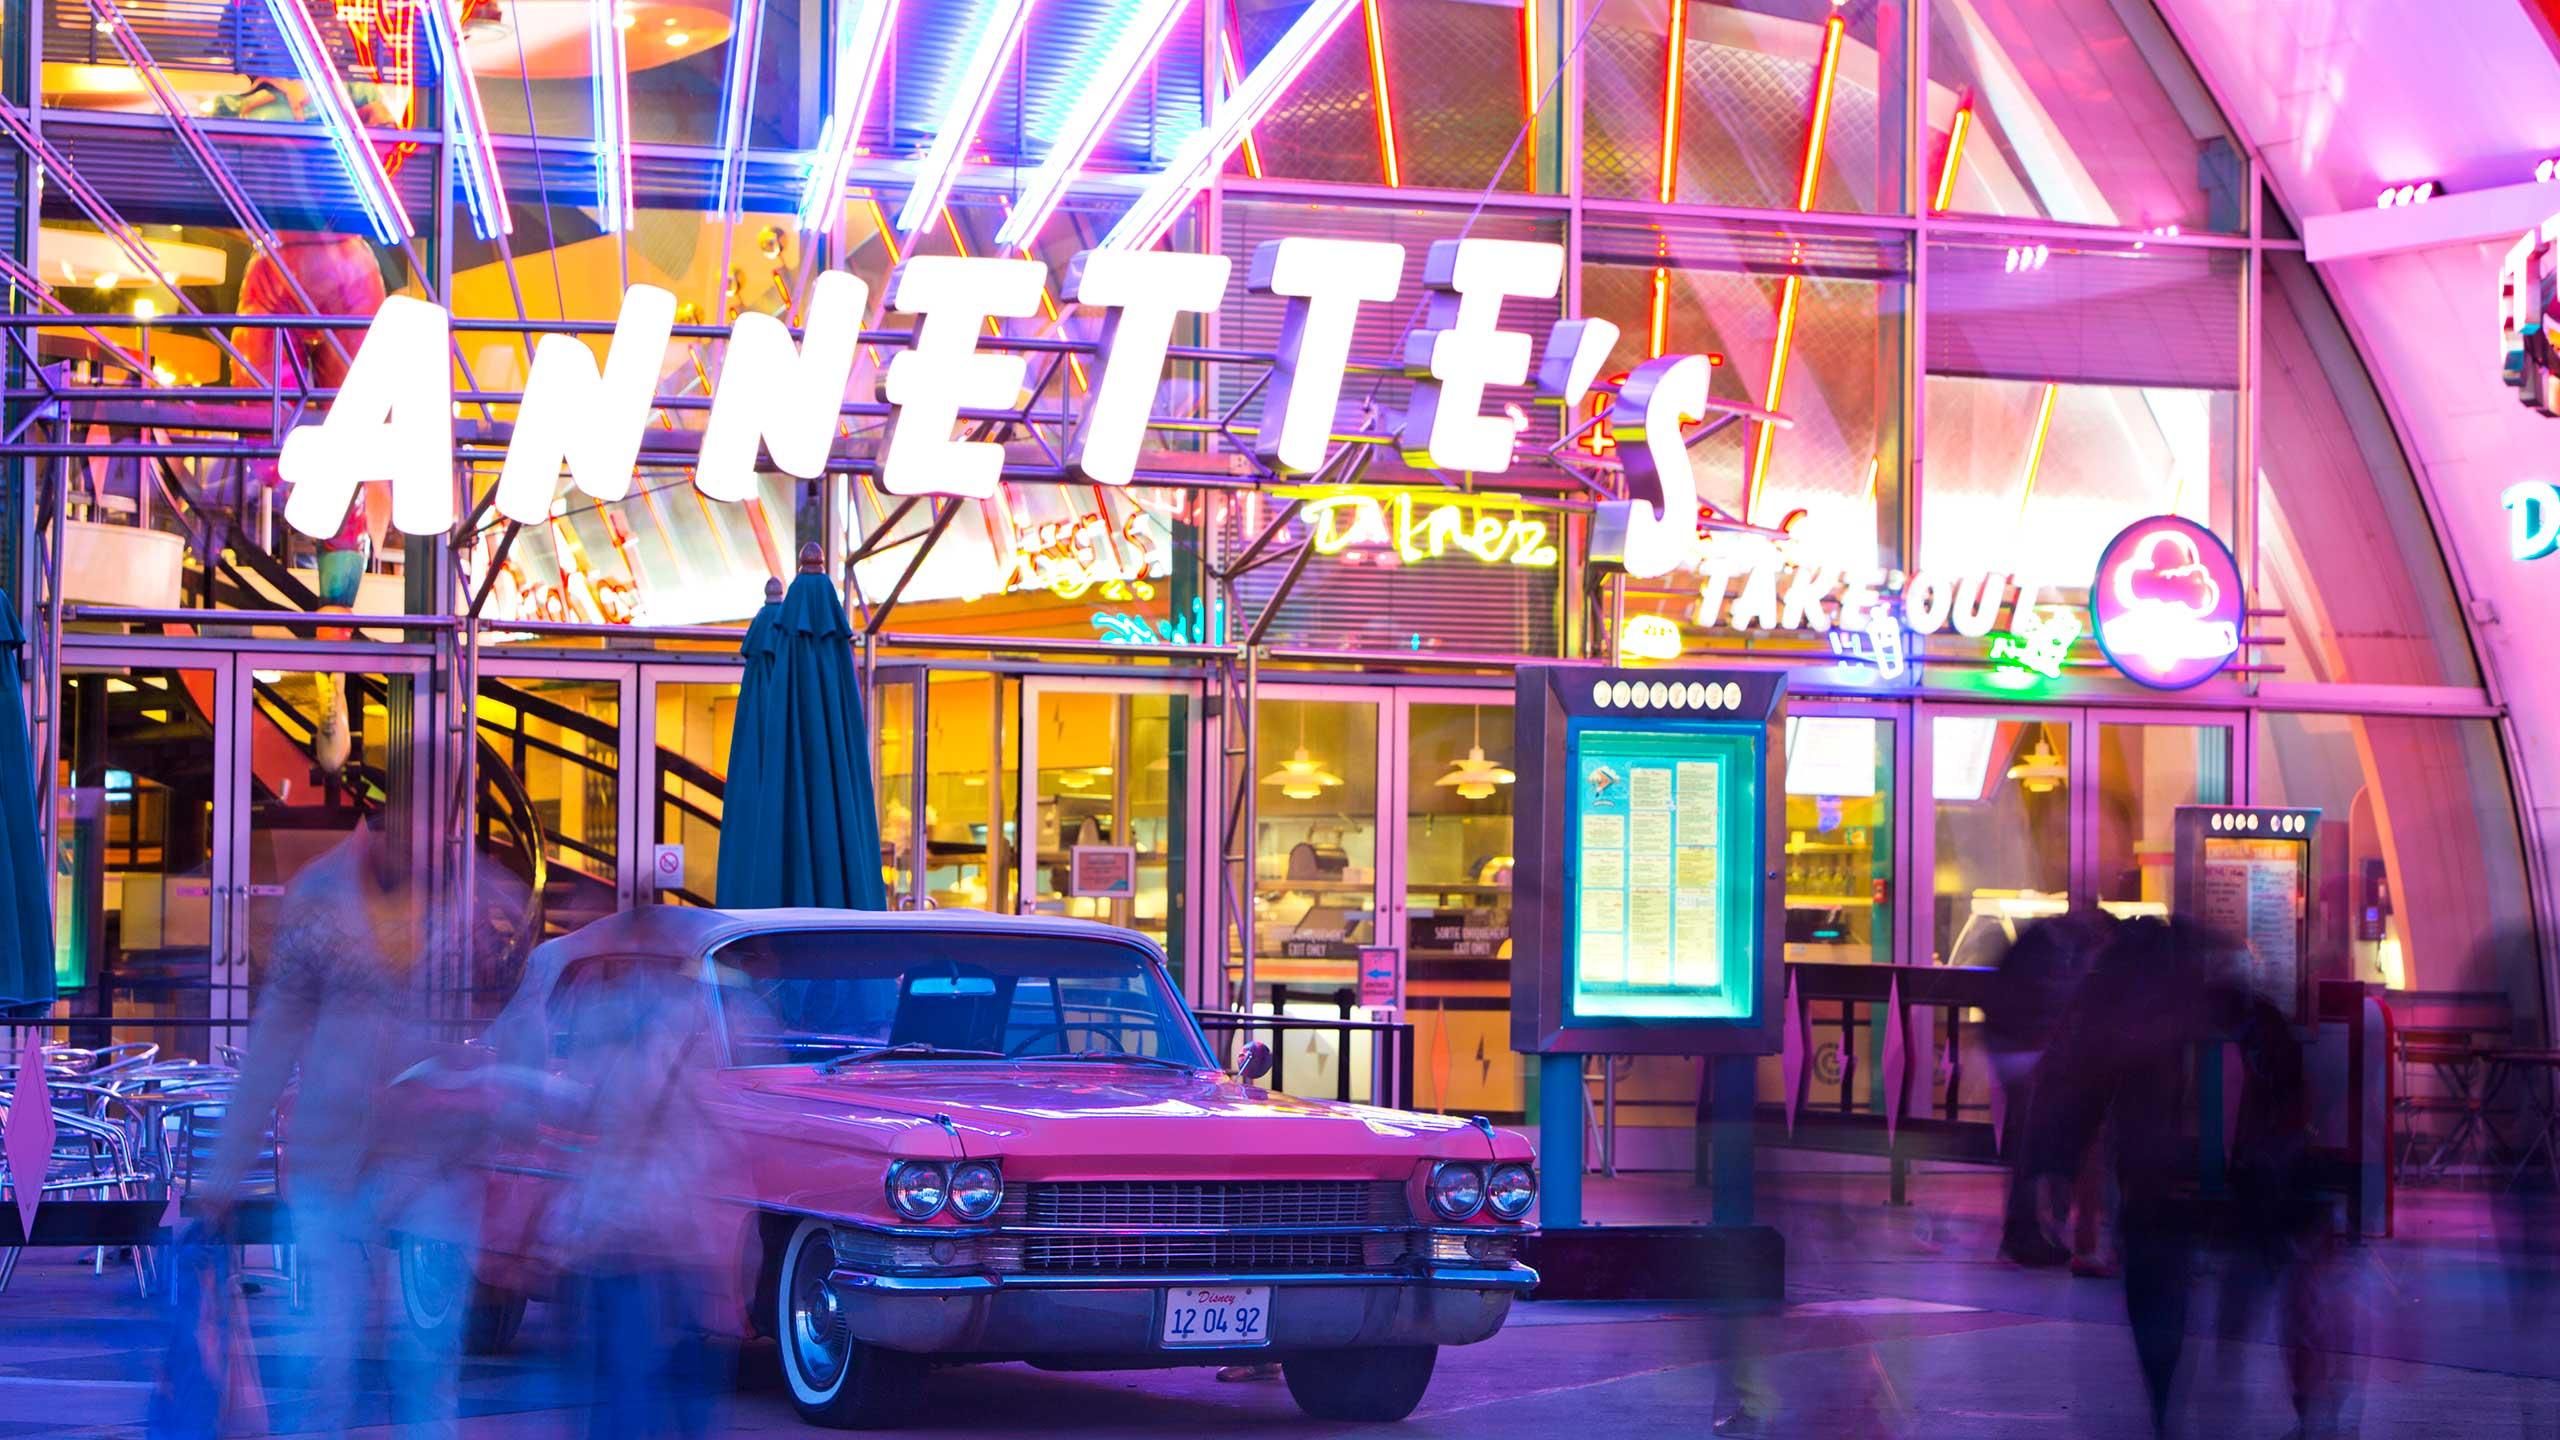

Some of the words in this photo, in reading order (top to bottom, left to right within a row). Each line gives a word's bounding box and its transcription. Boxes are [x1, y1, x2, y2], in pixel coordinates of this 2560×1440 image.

[2502, 481, 2560, 561] D
[1696, 560, 1882, 633] TAKE
[1903, 568, 2052, 638] OUT
[1306, 943, 1328, 958] ONLY
[1198, 1290, 1236, 1305] Disney
[1171, 1308, 1197, 1334] 12
[1203, 1307, 1228, 1333] 04
[1235, 1307, 1261, 1333] 92
